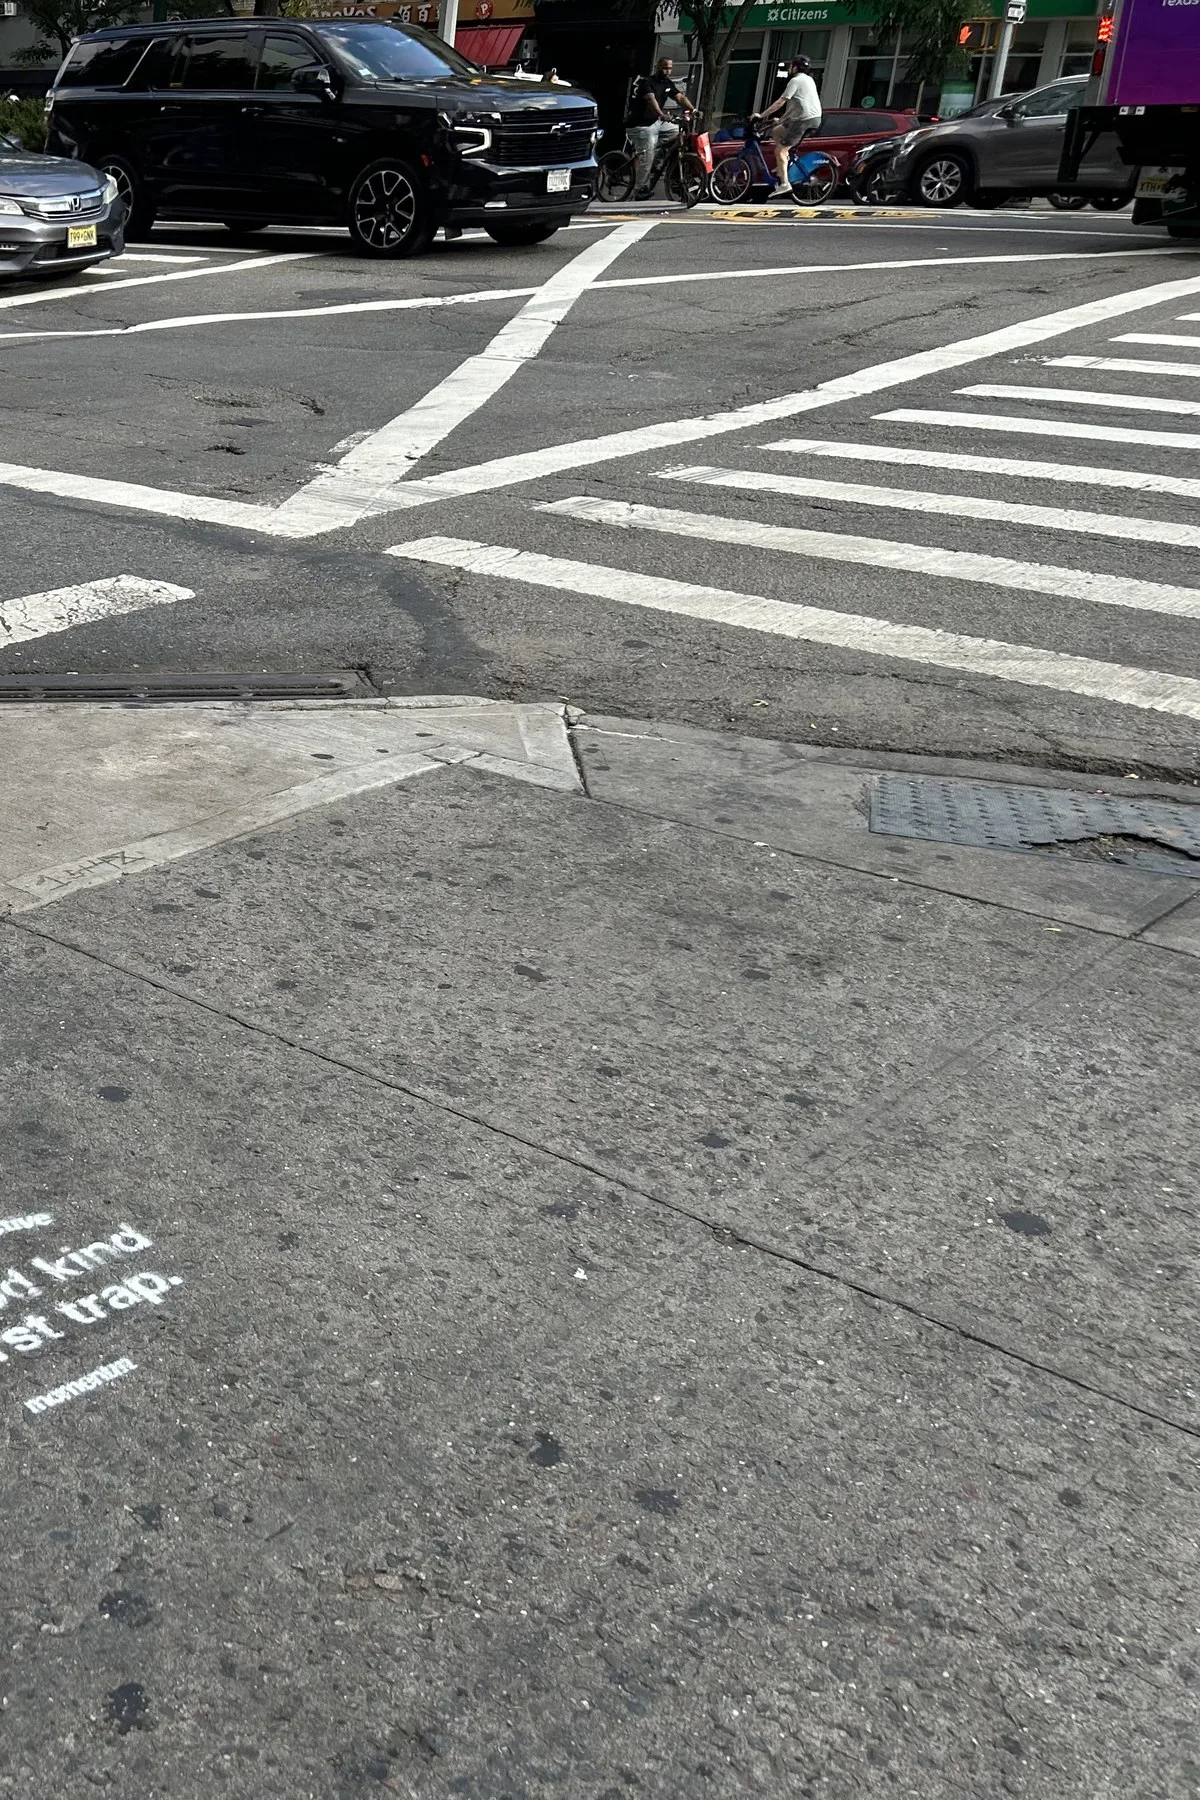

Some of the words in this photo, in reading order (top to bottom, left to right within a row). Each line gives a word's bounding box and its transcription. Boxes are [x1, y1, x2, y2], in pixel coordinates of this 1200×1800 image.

[780, 8, 828, 20] Citizens
[32, 1222, 153, 1282] kind
[55, 1270, 185, 1324] trap.
